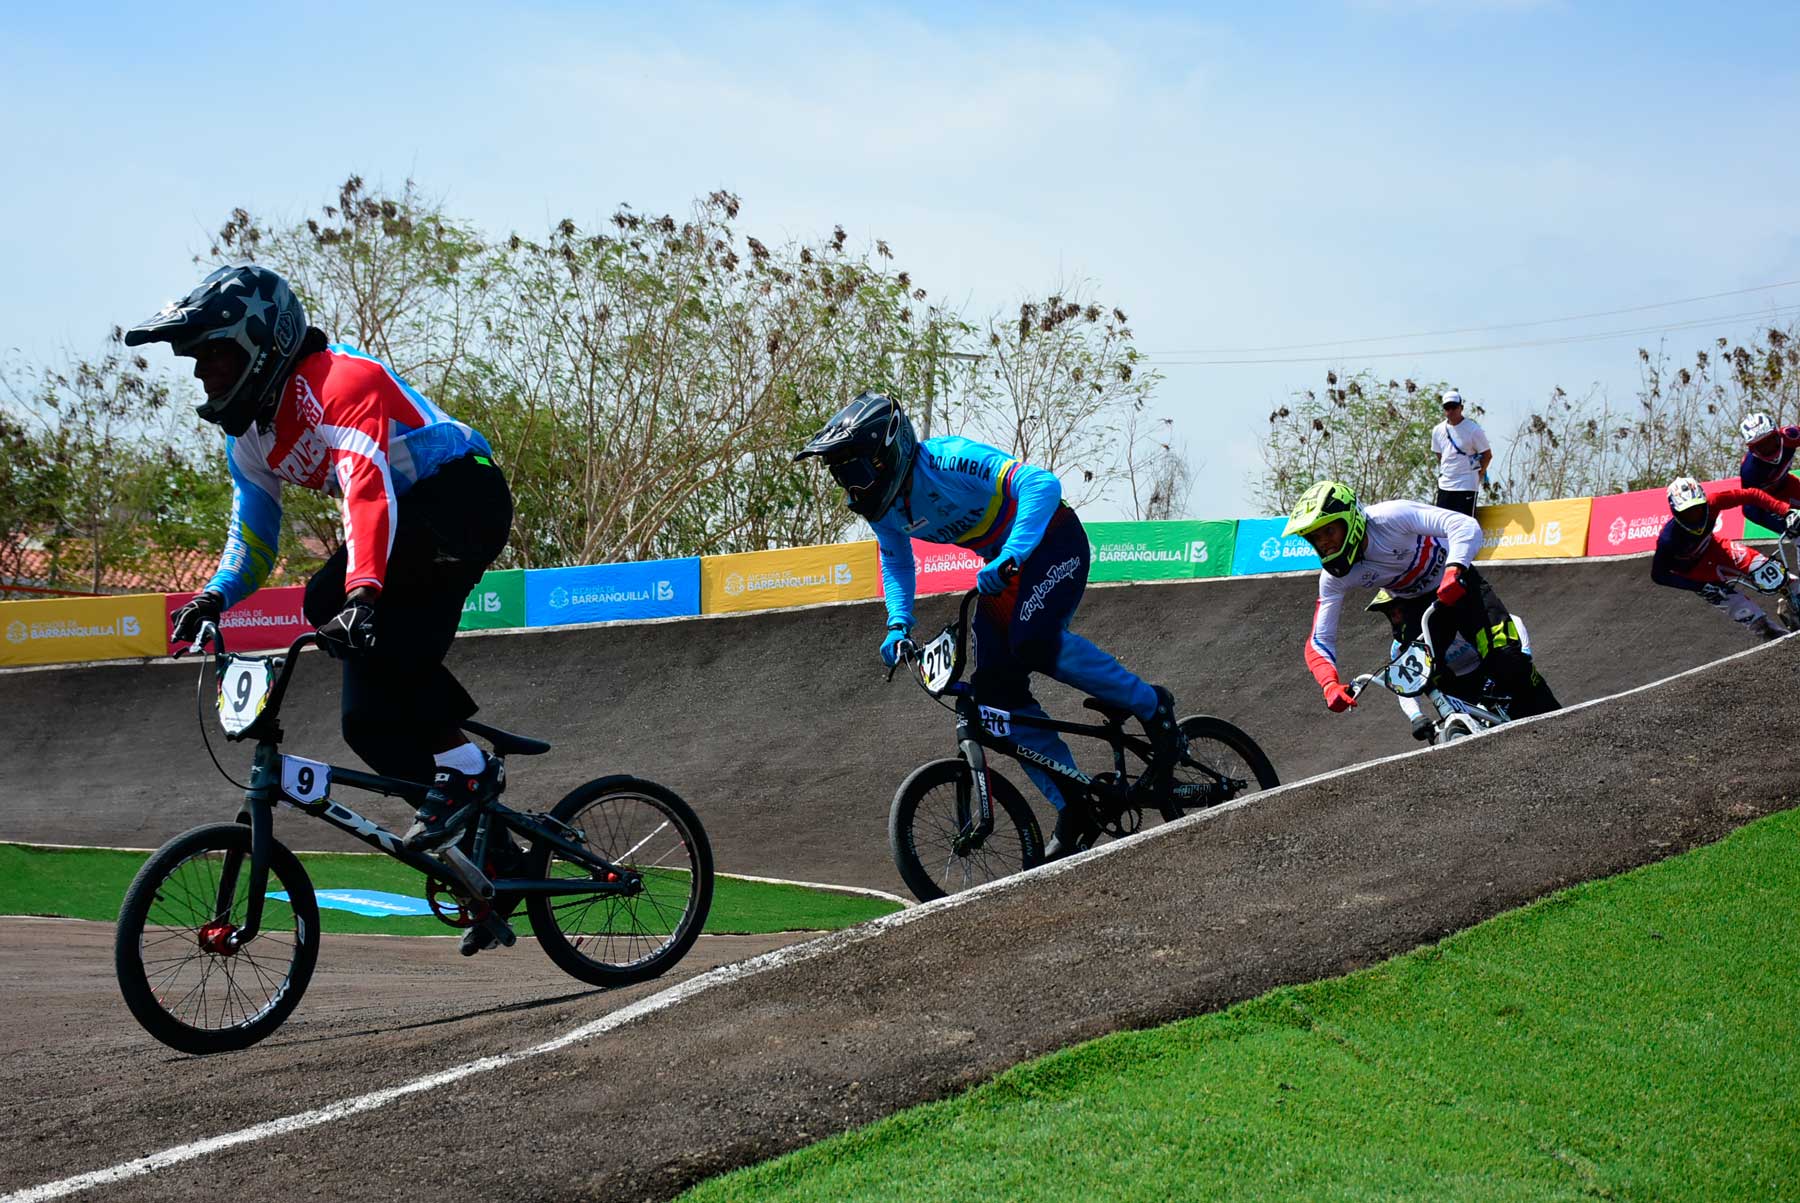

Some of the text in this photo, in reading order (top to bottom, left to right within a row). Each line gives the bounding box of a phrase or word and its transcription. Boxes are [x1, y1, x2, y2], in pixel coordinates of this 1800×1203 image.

[929, 454, 990, 481] COLOMBIA
[1629, 514, 1669, 526] ALCALDÍA DE
[1100, 543, 1147, 552] ALCALDÍA DE
[925, 552, 967, 563] ALCALDÍA DE
[1099, 550, 1181, 562] BARRANQUILLA
[924, 557, 986, 573] BARRANQUI
[748, 575, 826, 591] BARRANQUILLA
[1760, 566, 1779, 584] 19
[572, 590, 650, 605] BARRANQUILLA
[253, 608, 263, 617] DE
[218, 614, 299, 628] BARRANQUILLA
[31, 625, 115, 639] BARRANQUILLA
[927, 639, 952, 683] 278
[1398, 654, 1424, 684] 13
[233, 670, 253, 713] 9
[981, 709, 1006, 735] 278
[1017, 744, 1093, 785] WIAWIS
[296, 766, 315, 795] 9
[324, 799, 404, 851] DK
